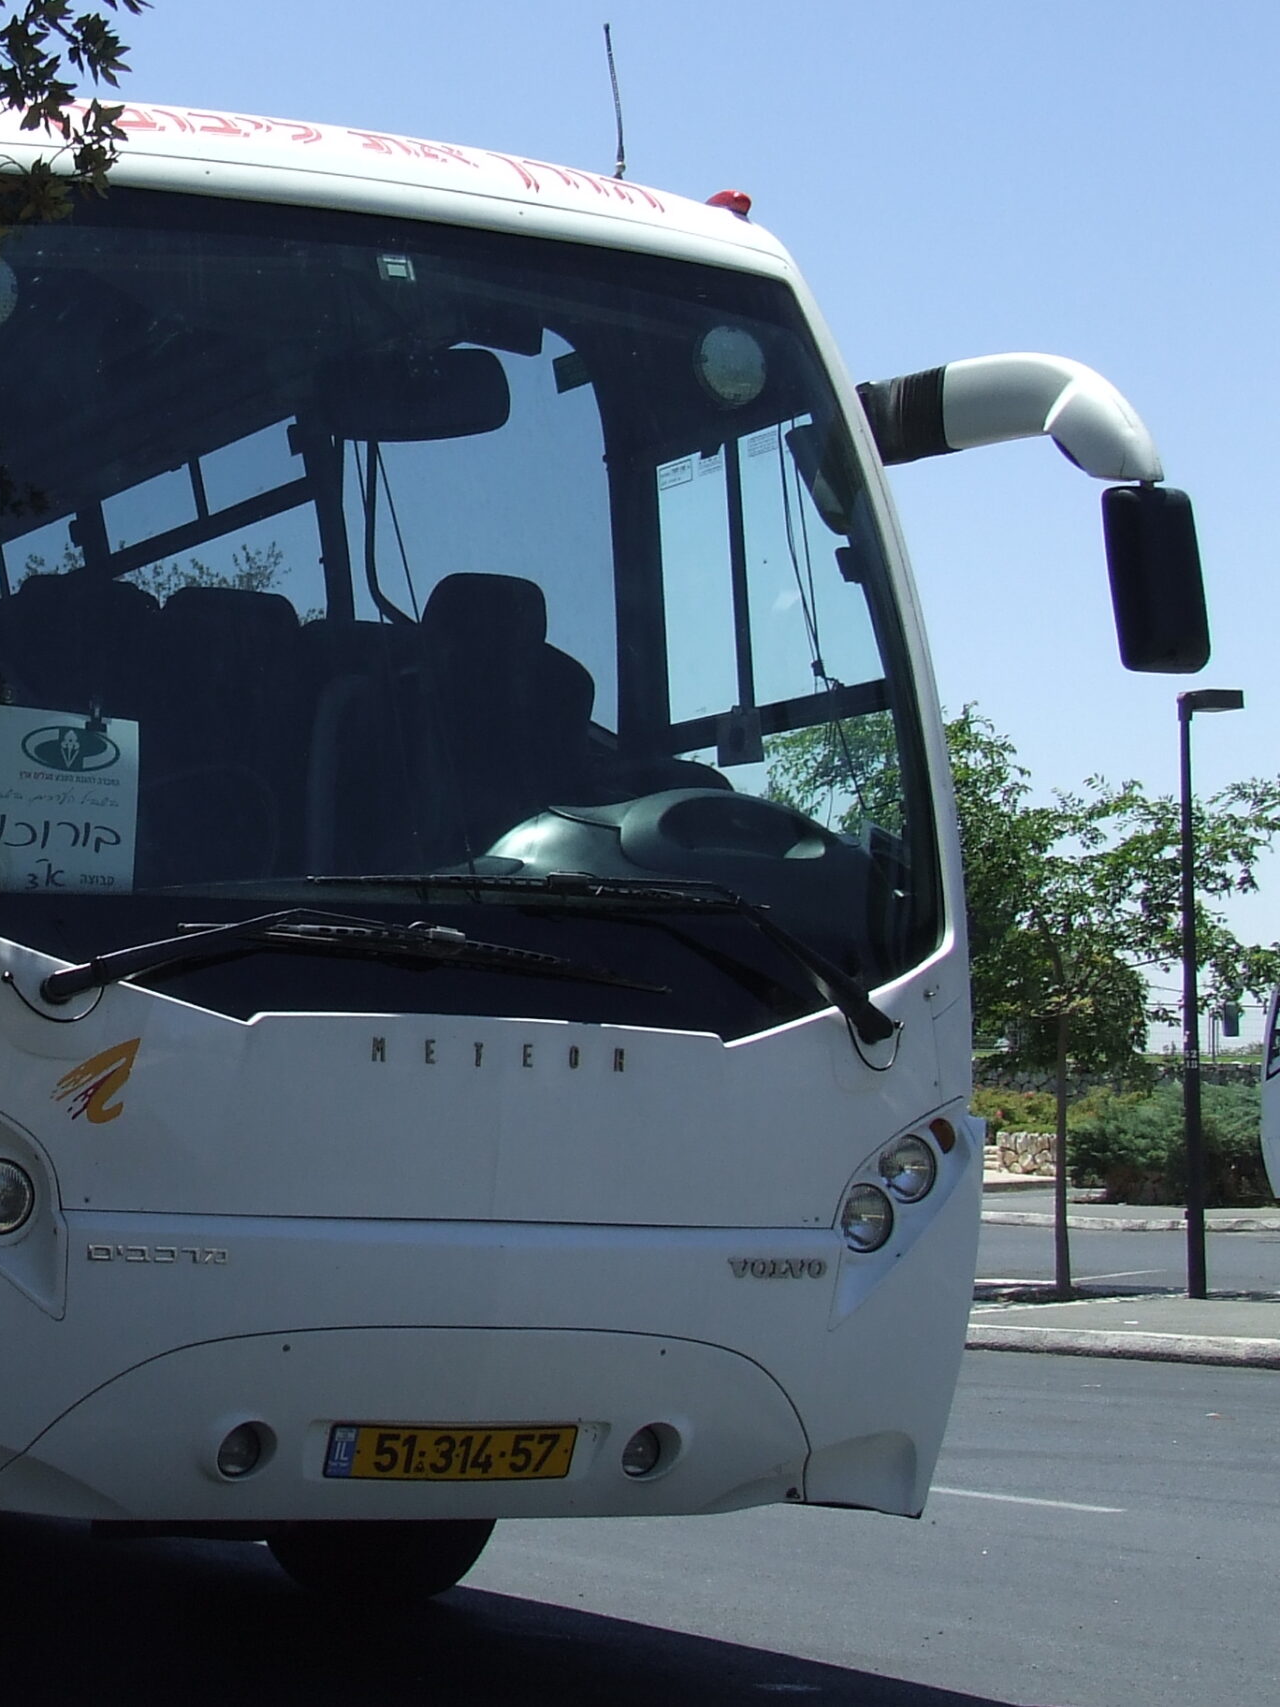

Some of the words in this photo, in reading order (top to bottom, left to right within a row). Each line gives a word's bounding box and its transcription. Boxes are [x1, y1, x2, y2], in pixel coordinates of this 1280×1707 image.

[80, 873, 115, 888] קבוצה
[371, 1037, 625, 1072] METEOR
[87, 1244, 229, 1265] מרכבים
[727, 1258, 828, 1279] VOLVO
